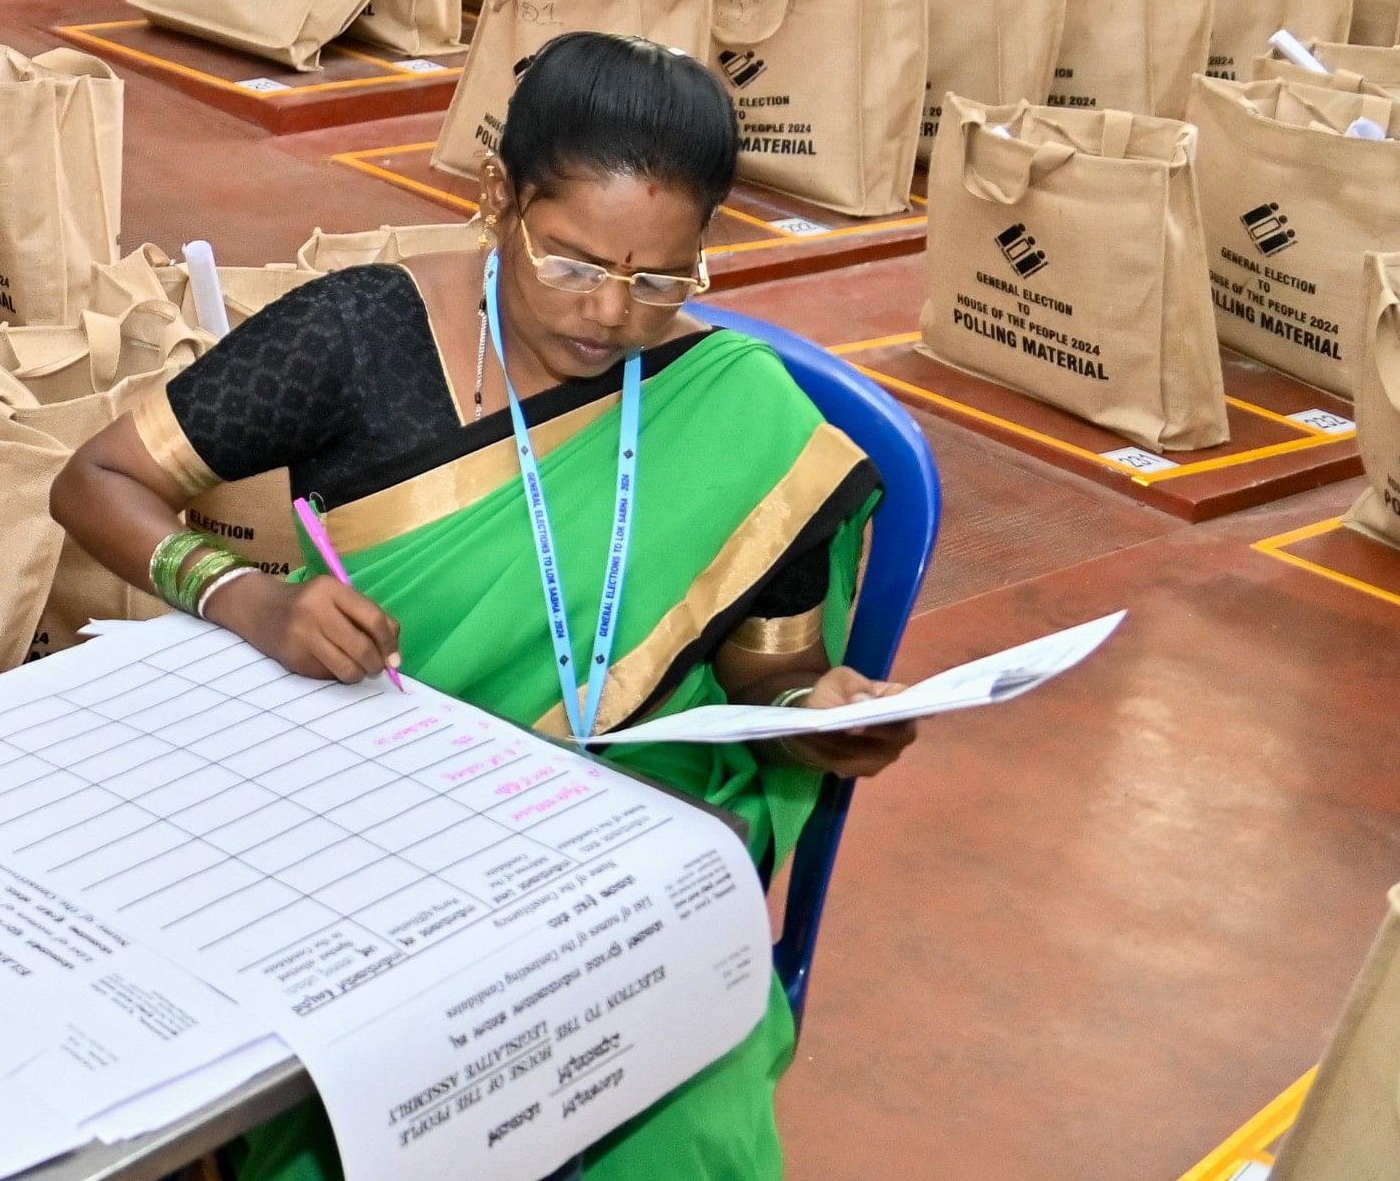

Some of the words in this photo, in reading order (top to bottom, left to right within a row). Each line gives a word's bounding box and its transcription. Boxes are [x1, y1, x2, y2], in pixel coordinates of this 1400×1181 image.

[738, 94, 790, 108] ELECTION
[1068, 95, 1097, 107] 2024
[743, 122, 786, 134] PEOPLE
[787, 122, 812, 135] 2024
[737, 137, 818, 156] MATERIAL
[1220, 245, 1262, 275] GENERAL
[1264, 265, 1317, 296] ELECTION
[1257, 278, 1271, 294] TO
[975, 270, 1020, 297] GENERAL
[1022, 288, 1073, 317] ELECTION
[1016, 301, 1031, 316] TO
[1231, 281, 1245, 297] OF
[1247, 288, 1266, 307] THE
[1267, 299, 1308, 325] PEOPLE
[1309, 315, 1340, 336] 2024
[956, 292, 988, 315] HOUSE
[990, 306, 1005, 320] OF
[1007, 312, 1026, 330] THE
[1028, 321, 1069, 345] PEOPLE
[1070, 336, 1101, 357] 2024
[1260, 312, 1343, 362] MATERIAL
[953, 307, 1018, 349] POLLING
[1021, 334, 1110, 382] MATERIAL
[526, 471, 543, 510] GENERAL
[189, 508, 255, 540] ELECTION
[616, 497, 629, 525] SABHA
[612, 542, 623, 554] TO
[614, 524, 626, 543] LOK
[605, 554, 621, 599] ELECTIONS
[598, 602, 614, 638] GENERAL
[606, 964, 666, 1011] ELECTION
[555, 1016, 582, 1043] THE
[585, 1003, 602, 1023] TO
[464, 1019, 549, 1078] LEGISLATIVE
[509, 1044, 554, 1083] HOUSE
[387, 1070, 459, 1126] ASSEMBLY
[455, 1087, 483, 1114] THE
[486, 1073, 505, 1095] OF
[398, 1107, 451, 1147] PEOPLE
